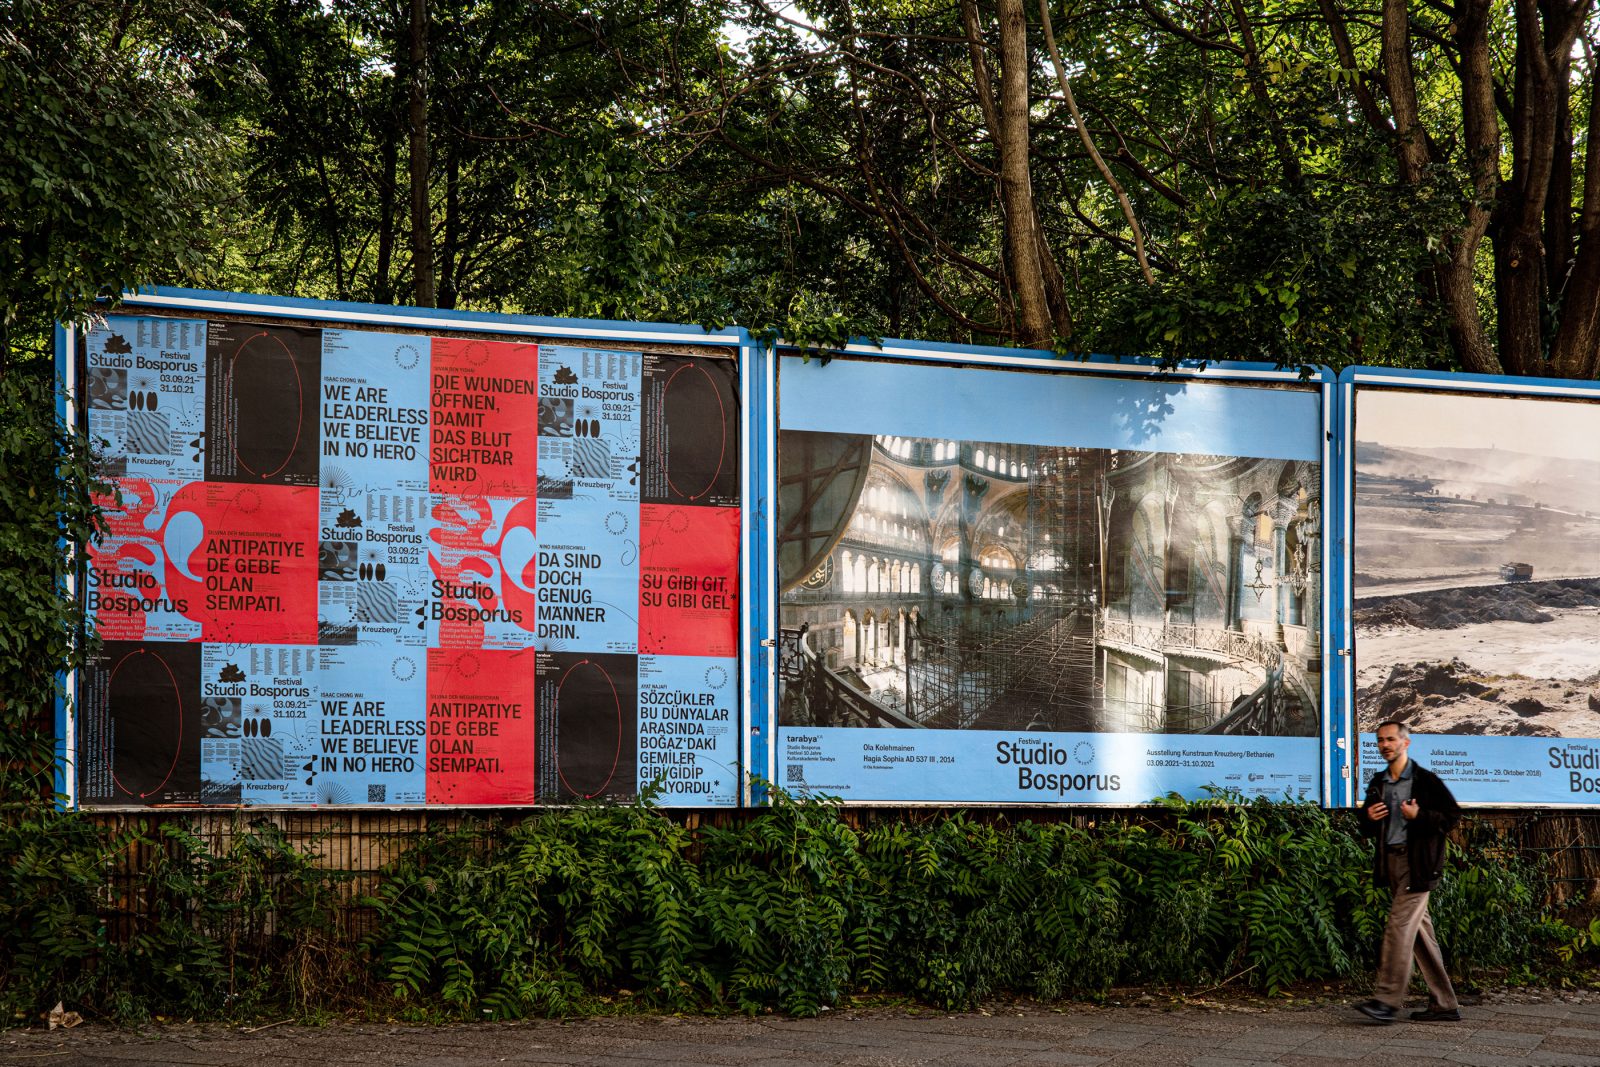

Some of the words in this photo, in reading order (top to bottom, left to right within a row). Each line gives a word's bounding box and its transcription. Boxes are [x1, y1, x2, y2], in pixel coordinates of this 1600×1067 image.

[90, 352, 132, 368] Studio
[136, 356, 198, 373] Bosporus
[160, 350, 190, 360] Festival
[160, 384, 194, 394] 31.10.21
[434, 374, 459, 390] DIE
[464, 376, 534, 395] WUNDEN
[602, 381, 628, 390] Festival
[324, 384, 350, 401] WE
[356, 388, 388, 404] ARE
[540, 384, 578, 398] Studio
[582, 386, 634, 402] Bosporus
[432, 392, 500, 413] ÖFFNEN,
[324, 403, 428, 425] LEADERLESS
[434, 411, 485, 428] DAMIT
[602, 413, 631, 422] 31.10.21
[324, 422, 350, 439] WE
[356, 424, 420, 443] BELIEVE
[434, 429, 467, 445] DAS
[472, 431, 512, 448] BLUT
[324, 440, 339, 456] IN
[346, 442, 367, 458] NO
[374, 444, 416, 461] HERO
[433, 448, 513, 466] SICHTBAR
[132, 457, 175, 468] Kreuzberg/
[433, 466, 476, 482] WIRD
[578, 480, 615, 490] Kreuzberg/
[388, 524, 415, 532] Festival
[322, 528, 363, 541] Studio
[366, 530, 422, 545] Bosporus
[207, 539, 304, 558] ANTIPATIYE
[207, 558, 229, 574] DE
[235, 559, 280, 574] GEBE
[388, 556, 419, 564] 31.10.21
[539, 553, 560, 567] DA
[565, 553, 601, 568] SIND
[88, 567, 156, 588] Studio
[206, 576, 252, 592] OLAN
[538, 571, 581, 585] DOCH
[642, 574, 662, 589] SU
[668, 575, 697, 590] GIBI
[432, 579, 494, 600] Studio
[538, 588, 592, 604] GENUG
[88, 591, 188, 616] Bosporus
[206, 595, 286, 612] SEMPATI.
[642, 592, 662, 606] SU
[667, 593, 696, 608] GIBI
[432, 602, 522, 626] Bosporus
[538, 605, 605, 622] MÄNNER
[362, 626, 402, 634] Kreuzberg/
[538, 624, 580, 639] DRIN.
[274, 678, 302, 686] Festival
[205, 683, 247, 696] Studio
[250, 684, 310, 699] Bosporus
[640, 690, 715, 706] SÖZCÜKLER
[274, 710, 307, 718] 31.10.21
[321, 701, 348, 716] WE
[353, 702, 385, 716] ARE
[429, 702, 522, 719] ANTIPATIYE
[640, 707, 657, 719] BU
[663, 705, 728, 720] DÜNYALAR
[321, 720, 426, 736] LEADERLESS
[430, 721, 451, 736] DE
[456, 721, 499, 736] GEBE
[640, 722, 704, 735] ARASINDA
[321, 738, 348, 754] WE
[354, 738, 418, 754] BELIEVE
[429, 739, 474, 754] OLAN
[875, 744, 915, 752] Kolehmainen
[996, 741, 1067, 765] Studio
[640, 749, 695, 764] GEMİLER
[863, 755, 882, 763] Hagia
[883, 756, 905, 764] Sophia
[1146, 750, 1181, 758] Ausstellung
[1214, 751, 1274, 759] Kreuzberg/Bethanien
[321, 757, 337, 772] IN
[344, 757, 366, 772] NO
[372, 757, 414, 773] HERO
[429, 758, 504, 773] SEMPATI.
[640, 764, 665, 779] GİBİ
[670, 764, 703, 779] GİDİP
[1526, 769, 1542, 777] 2018)
[246, 783, 288, 791] Kreuzberg/
[1018, 767, 1120, 796] Bosporus
